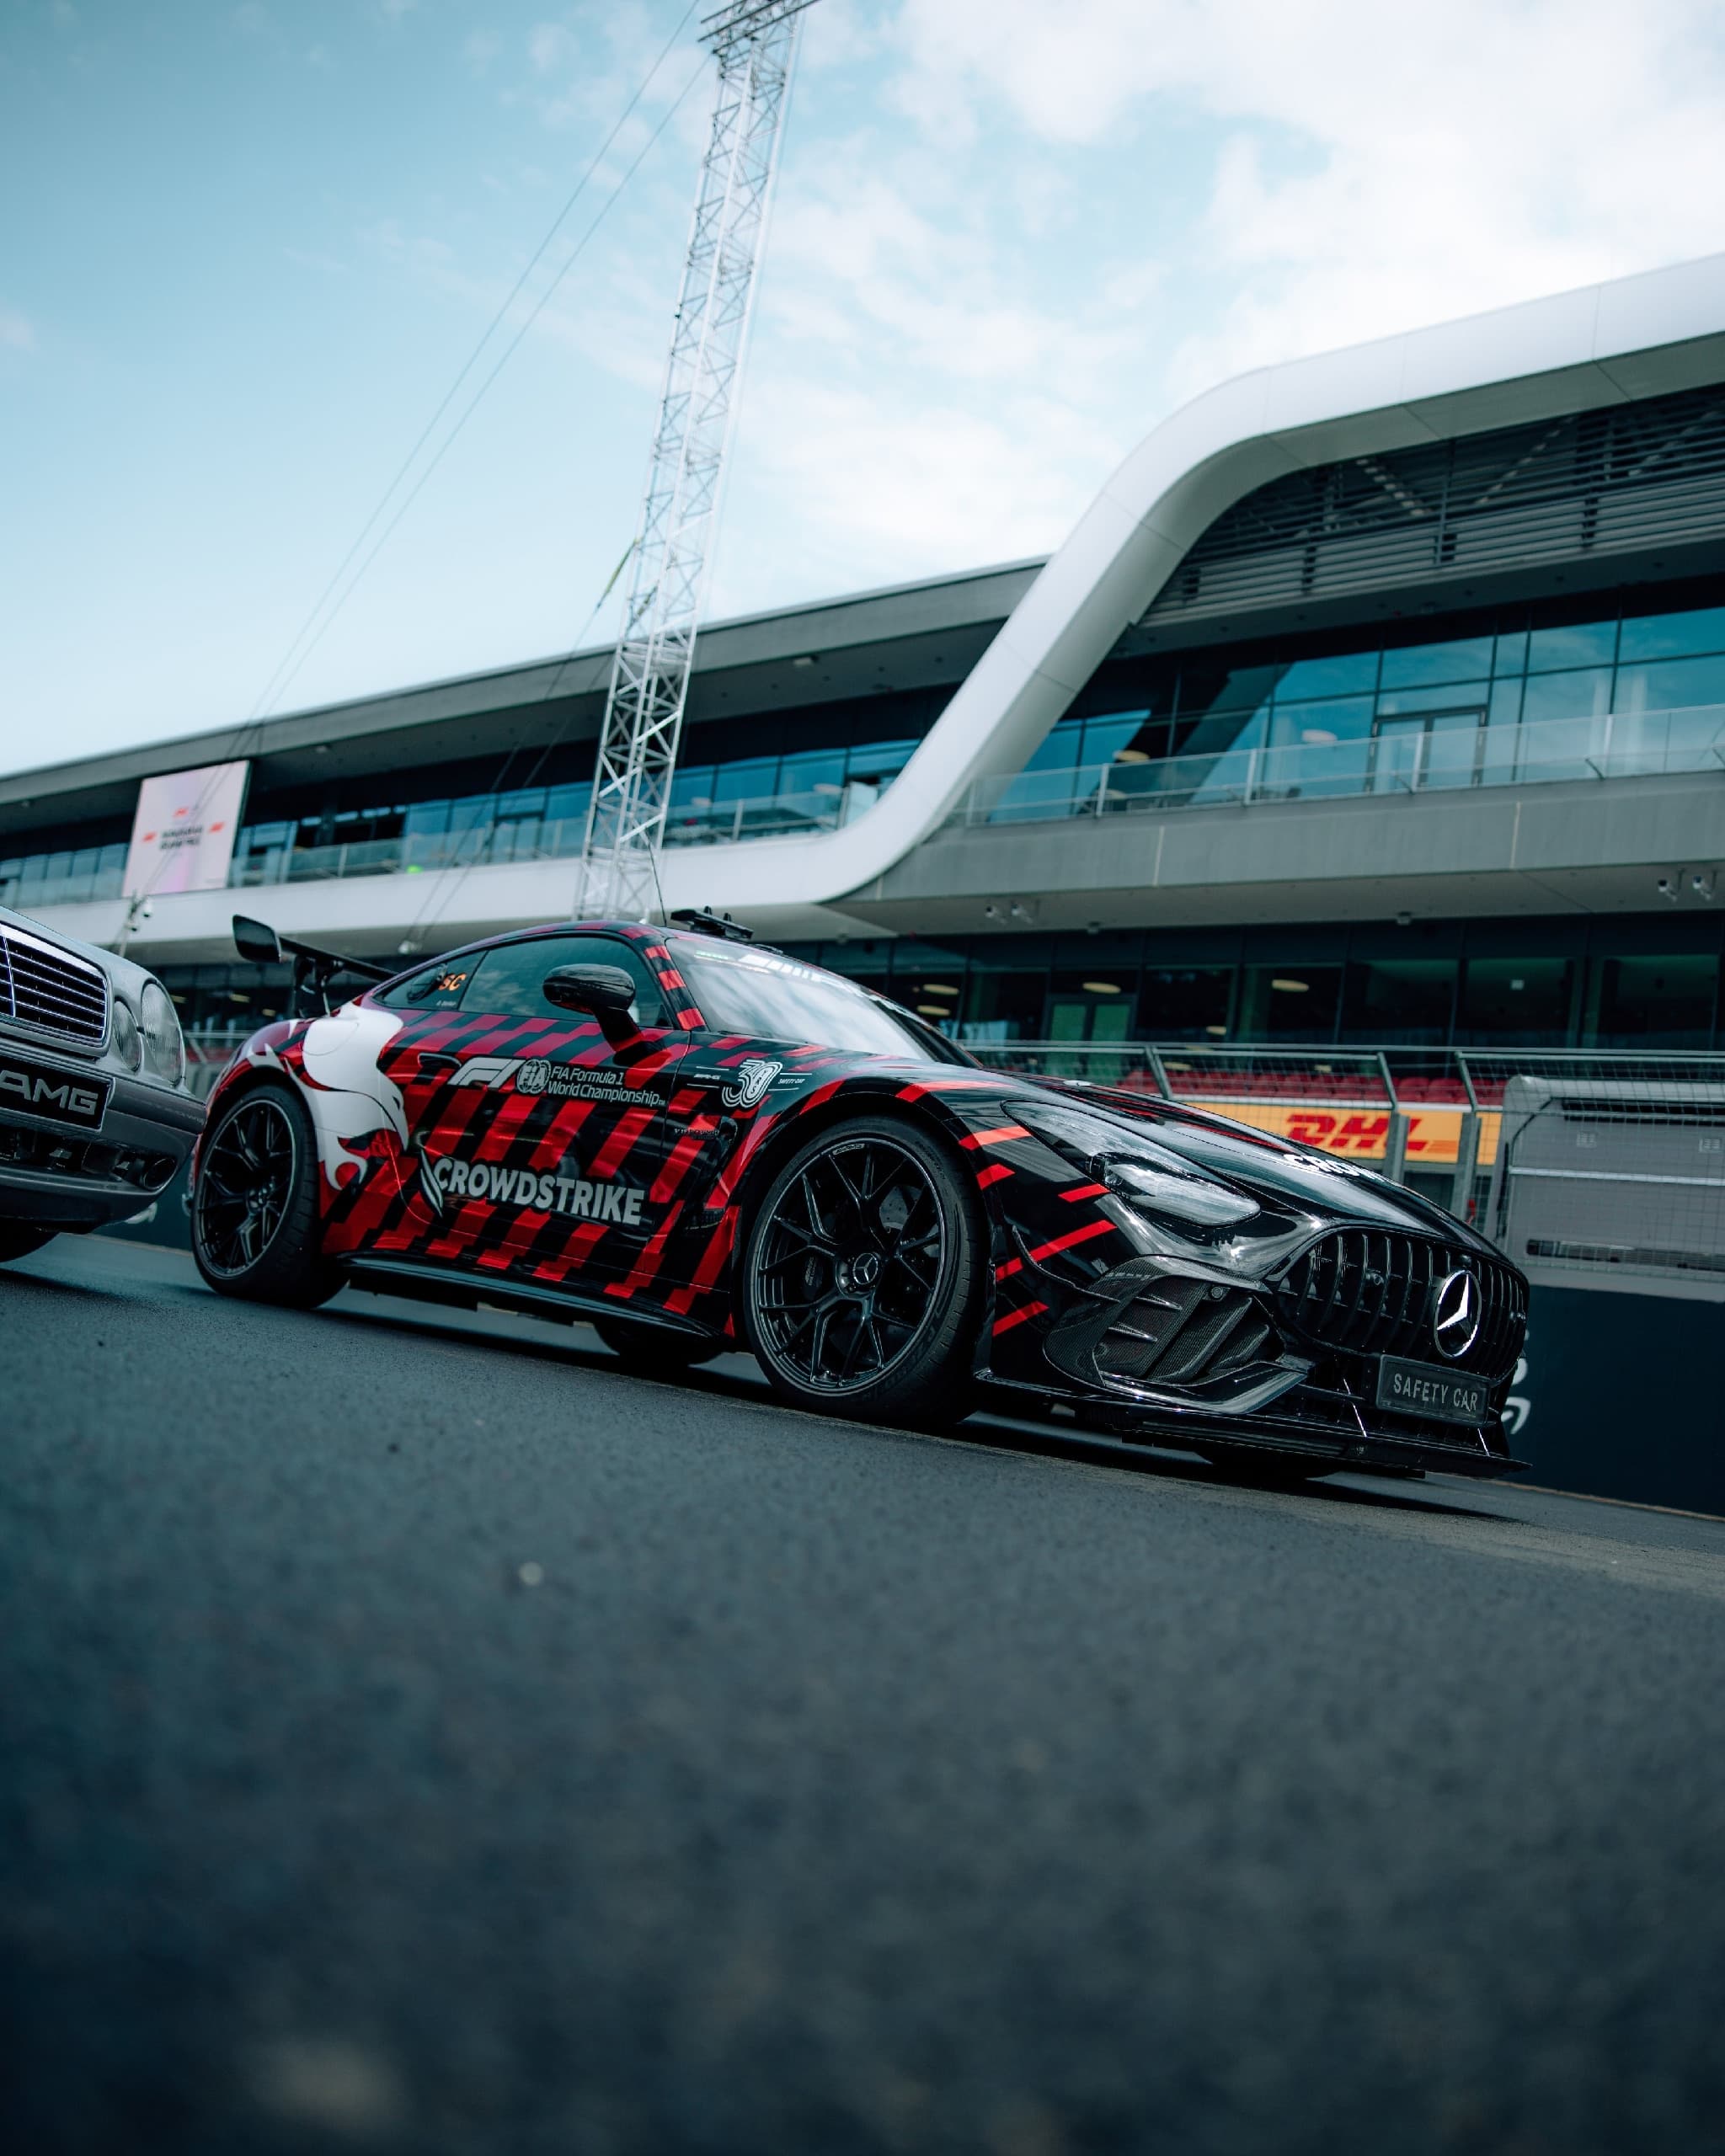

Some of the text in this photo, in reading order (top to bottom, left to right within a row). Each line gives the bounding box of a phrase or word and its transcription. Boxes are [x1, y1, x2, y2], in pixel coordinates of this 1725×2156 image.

[438, 973, 467, 991] SC
[518, 1065, 547, 1087] FIA
[551, 1066, 623, 1086] FIA Formula 1
[0, 1070, 99, 1116] AMG
[548, 1081, 577, 1096] World
[579, 1085, 660, 1107] Championship
[433, 1157, 645, 1225] CROWDSTRIKE
[1393, 1373, 1478, 1412] SAFETY CAR
